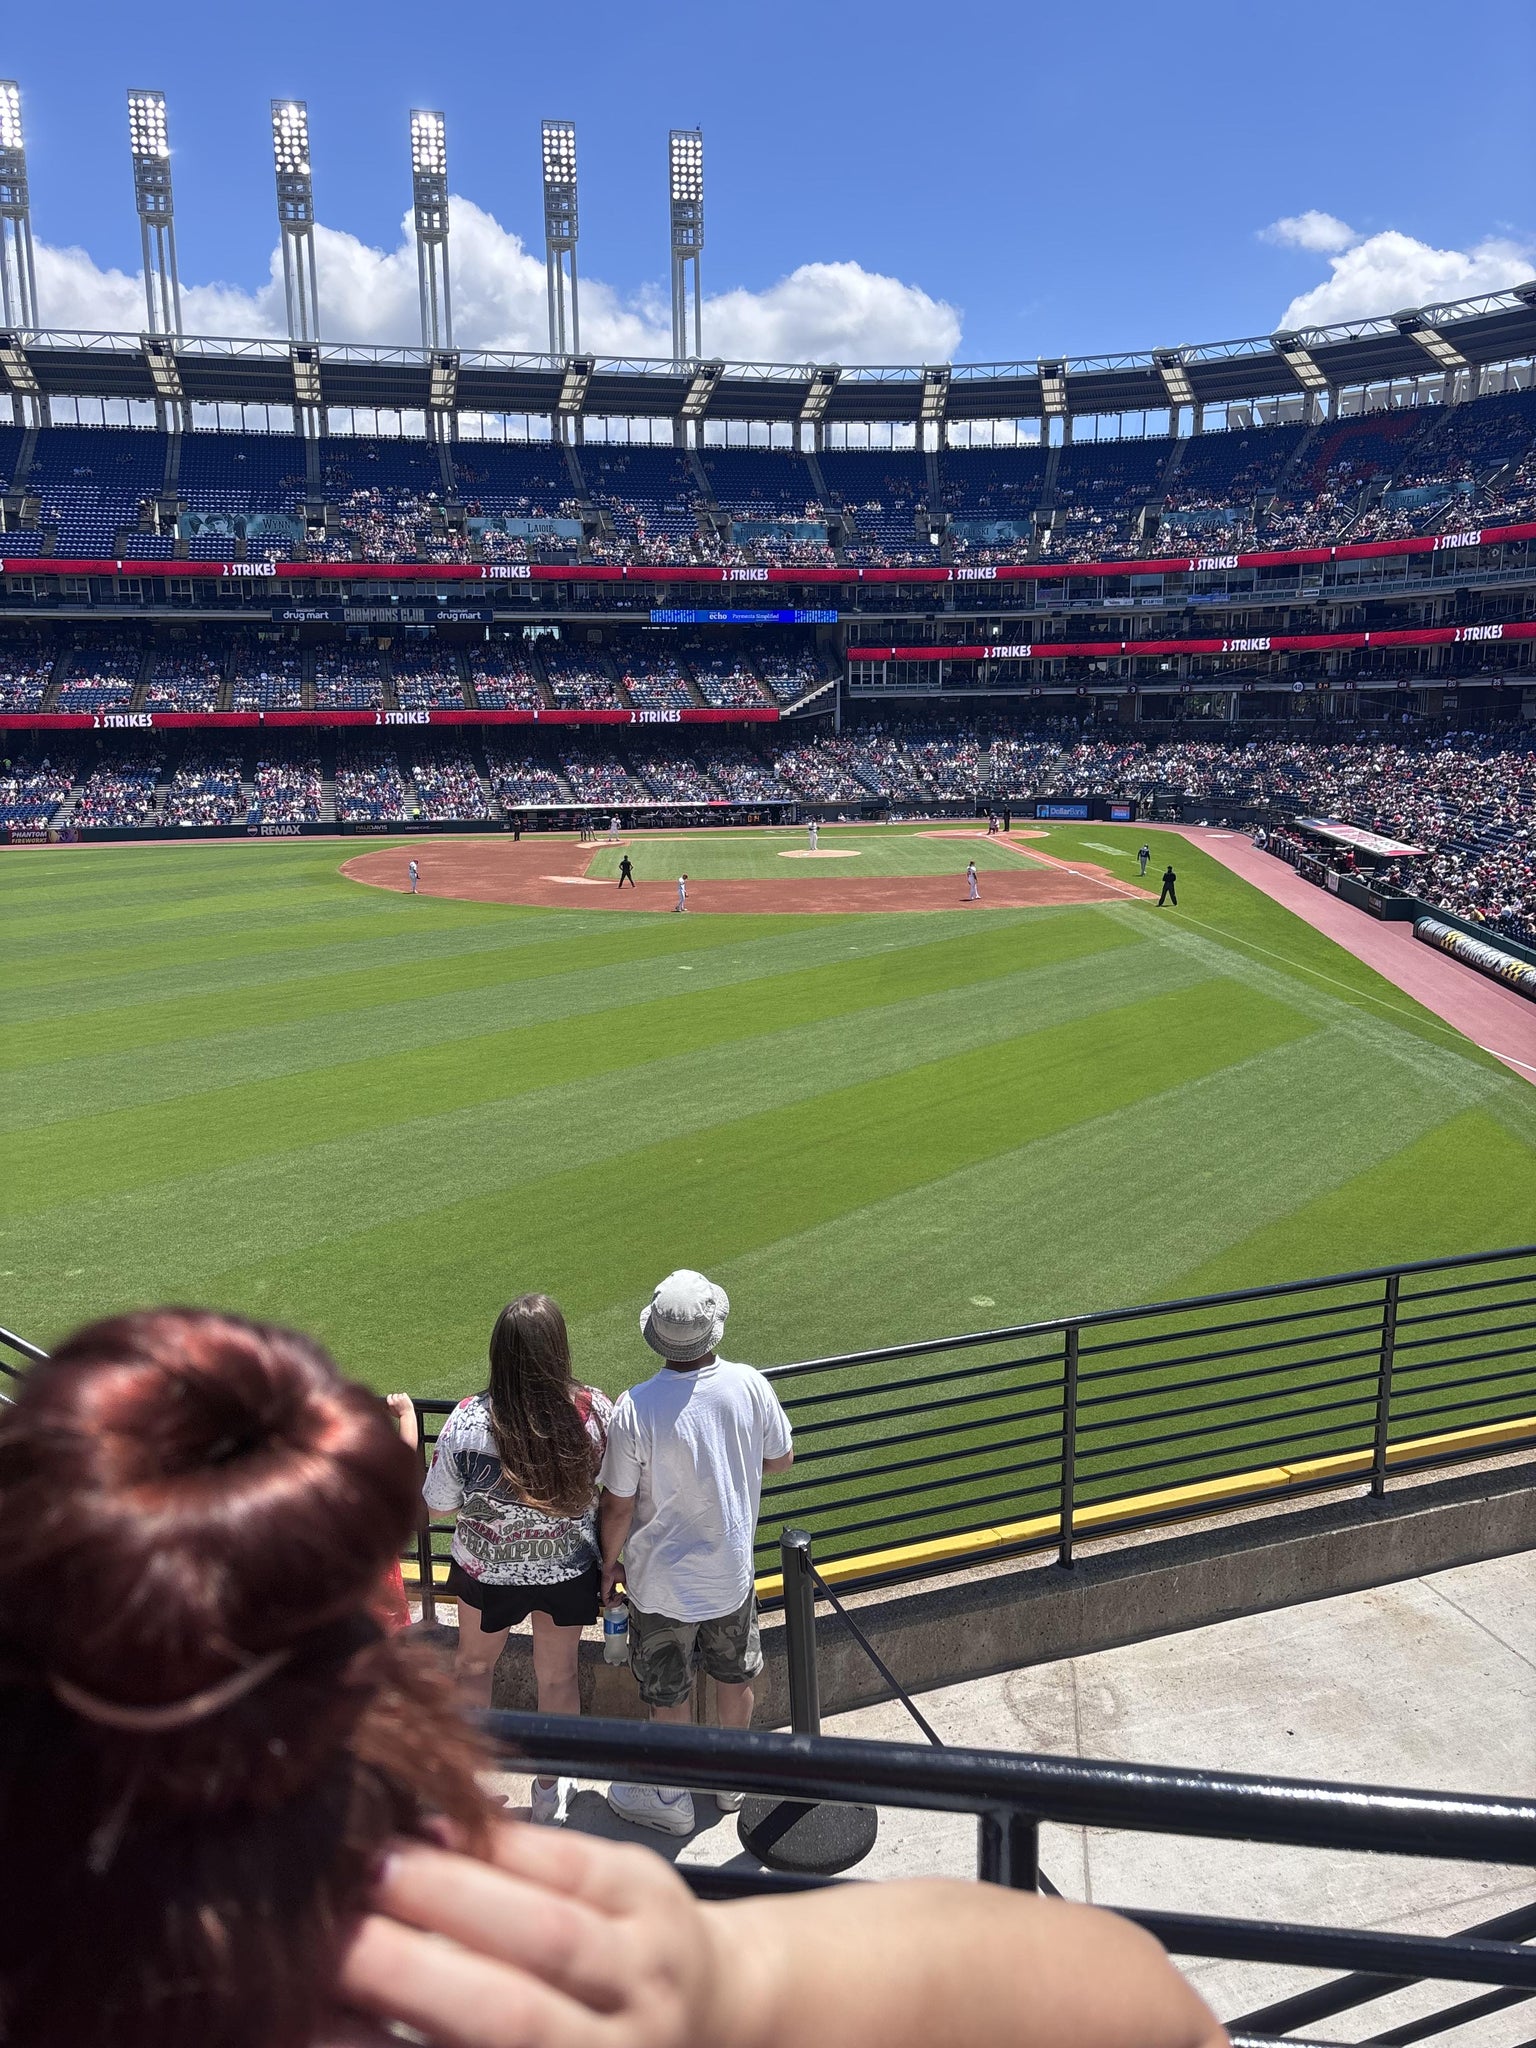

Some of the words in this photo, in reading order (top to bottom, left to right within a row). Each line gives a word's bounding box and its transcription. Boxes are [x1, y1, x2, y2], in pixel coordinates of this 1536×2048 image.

[262, 518, 291, 530] WYNN
[1433, 537, 1439, 551] 2
[1441, 530, 1482, 549] STRIKES
[222, 564, 229, 576] 2
[231, 564, 277, 576] STRIKES
[1188, 559, 1195, 572] 2
[1197, 555, 1238, 571] STRIKES
[480, 566, 487, 578] 2
[489, 566, 531, 578] STRIKES
[721, 569, 728, 581] 2
[730, 568, 769, 581] STRIKES
[947, 569, 954, 580] 2
[957, 567, 997, 580] STRIKES
[283, 611, 305, 621] drug
[306, 611, 329, 619] mart
[344, 609, 398, 622] CHAMPIONS
[400, 609, 425, 622] CLUB
[437, 611, 458, 621] drug
[459, 611, 481, 619] mart
[709, 612, 728, 620] echo
[1454, 628, 1461, 642] 2
[1462, 625, 1503, 641] STRIKES
[1221, 640, 1228, 652] 2
[1230, 637, 1271, 651] STRIKES
[983, 647, 990, 658] 2
[991, 645, 1032, 658] STRIKES
[93, 715, 101, 729] 2
[103, 713, 153, 728] STRIKES
[375, 712, 382, 725] 2
[384, 709, 431, 725] STRIKES
[630, 711, 637, 723] 2
[639, 709, 681, 723] STRIKES
[457, 1521, 582, 1564] CHAMPIONS
